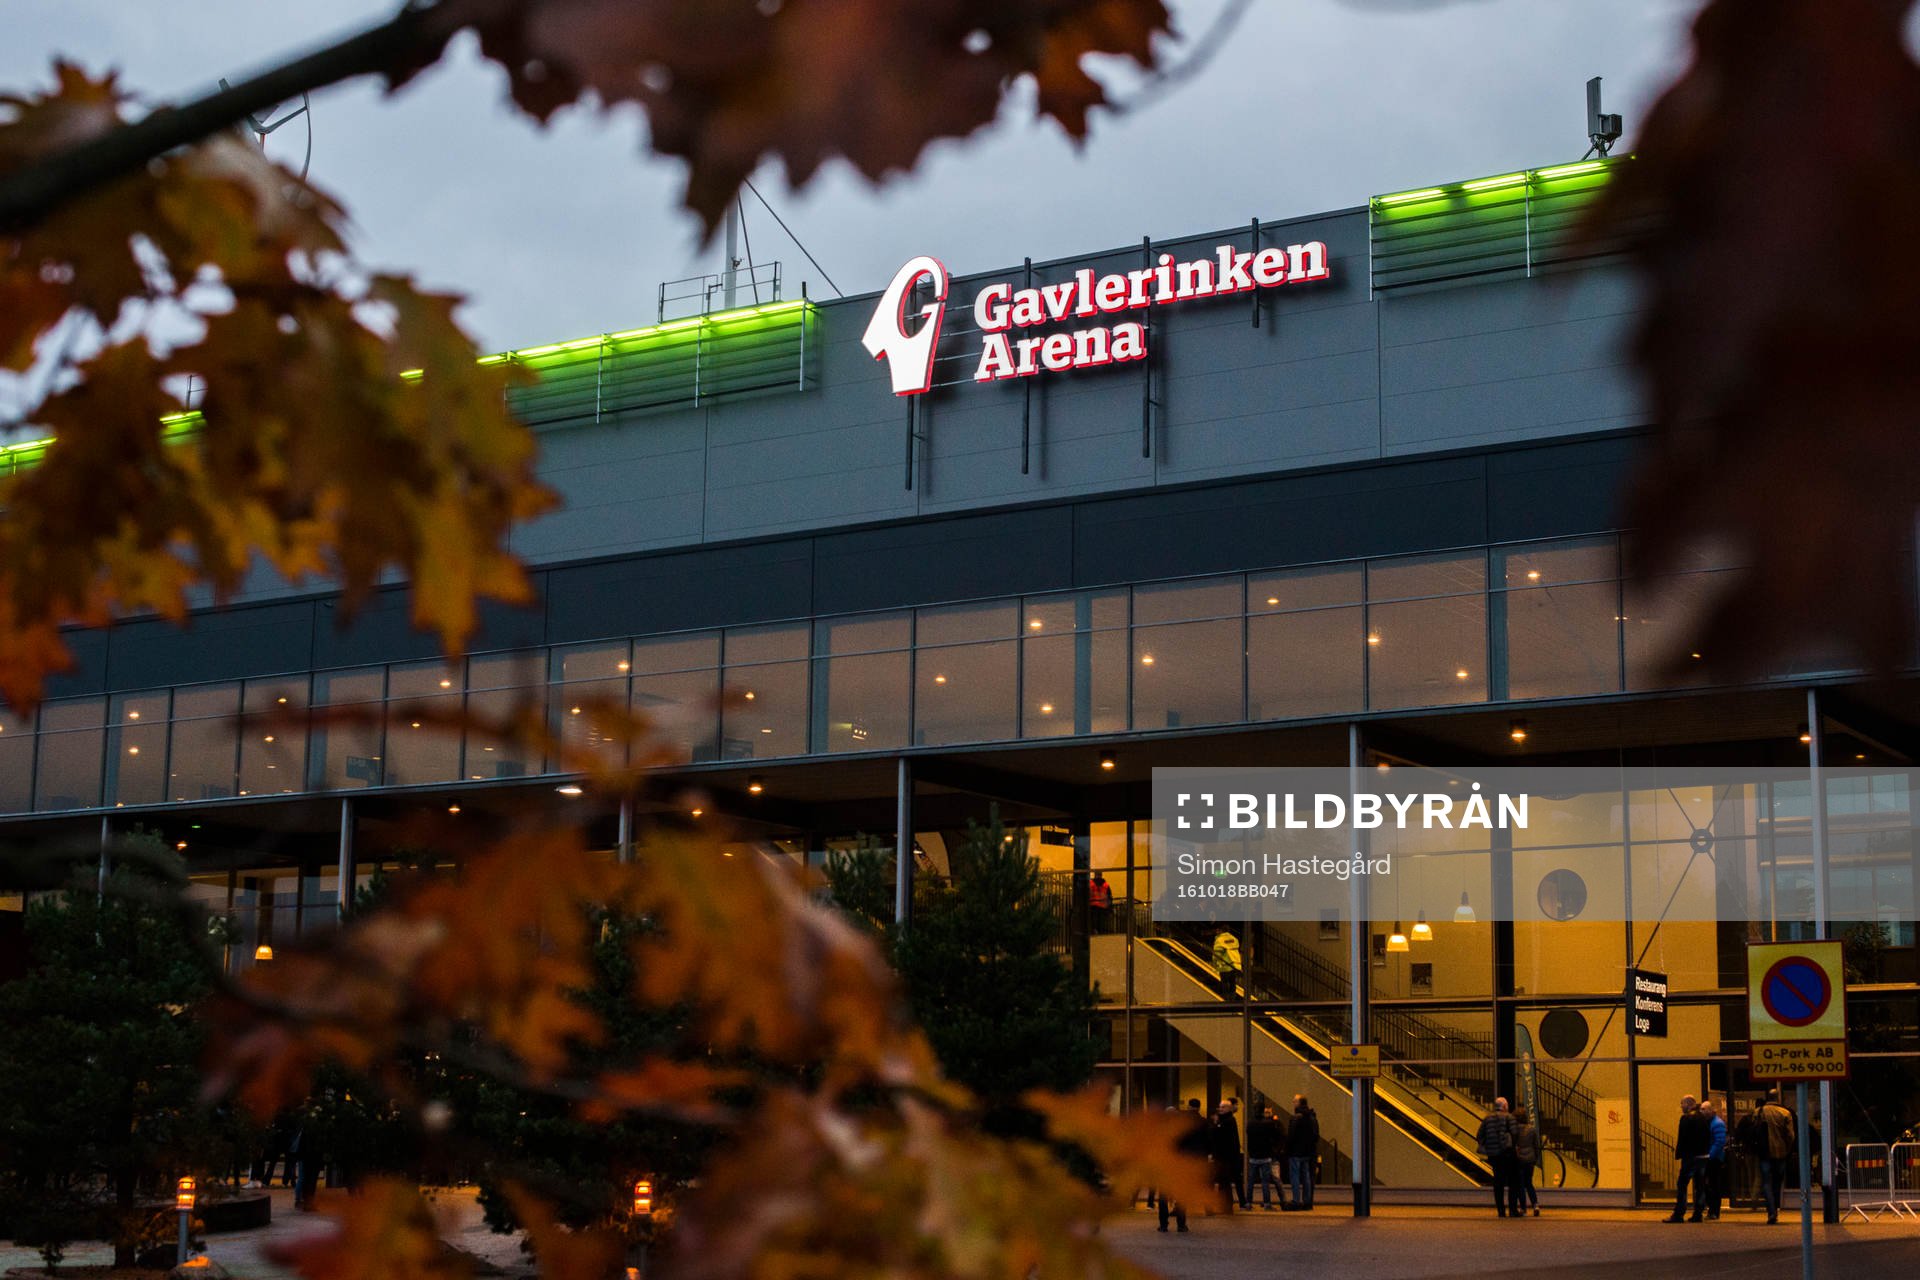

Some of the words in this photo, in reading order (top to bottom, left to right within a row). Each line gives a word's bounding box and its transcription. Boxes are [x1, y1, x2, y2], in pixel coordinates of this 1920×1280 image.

[973, 241, 1330, 332] Gavlerinken
[974, 322, 1147, 382] Arena
[1635, 976, 1667, 998] Restaurang
[1635, 995, 1664, 1013] Konferens
[1635, 1014, 1650, 1033] Loge
[1763, 1048, 1810, 1059] Q-Park
[1816, 1047, 1834, 1058] AB
